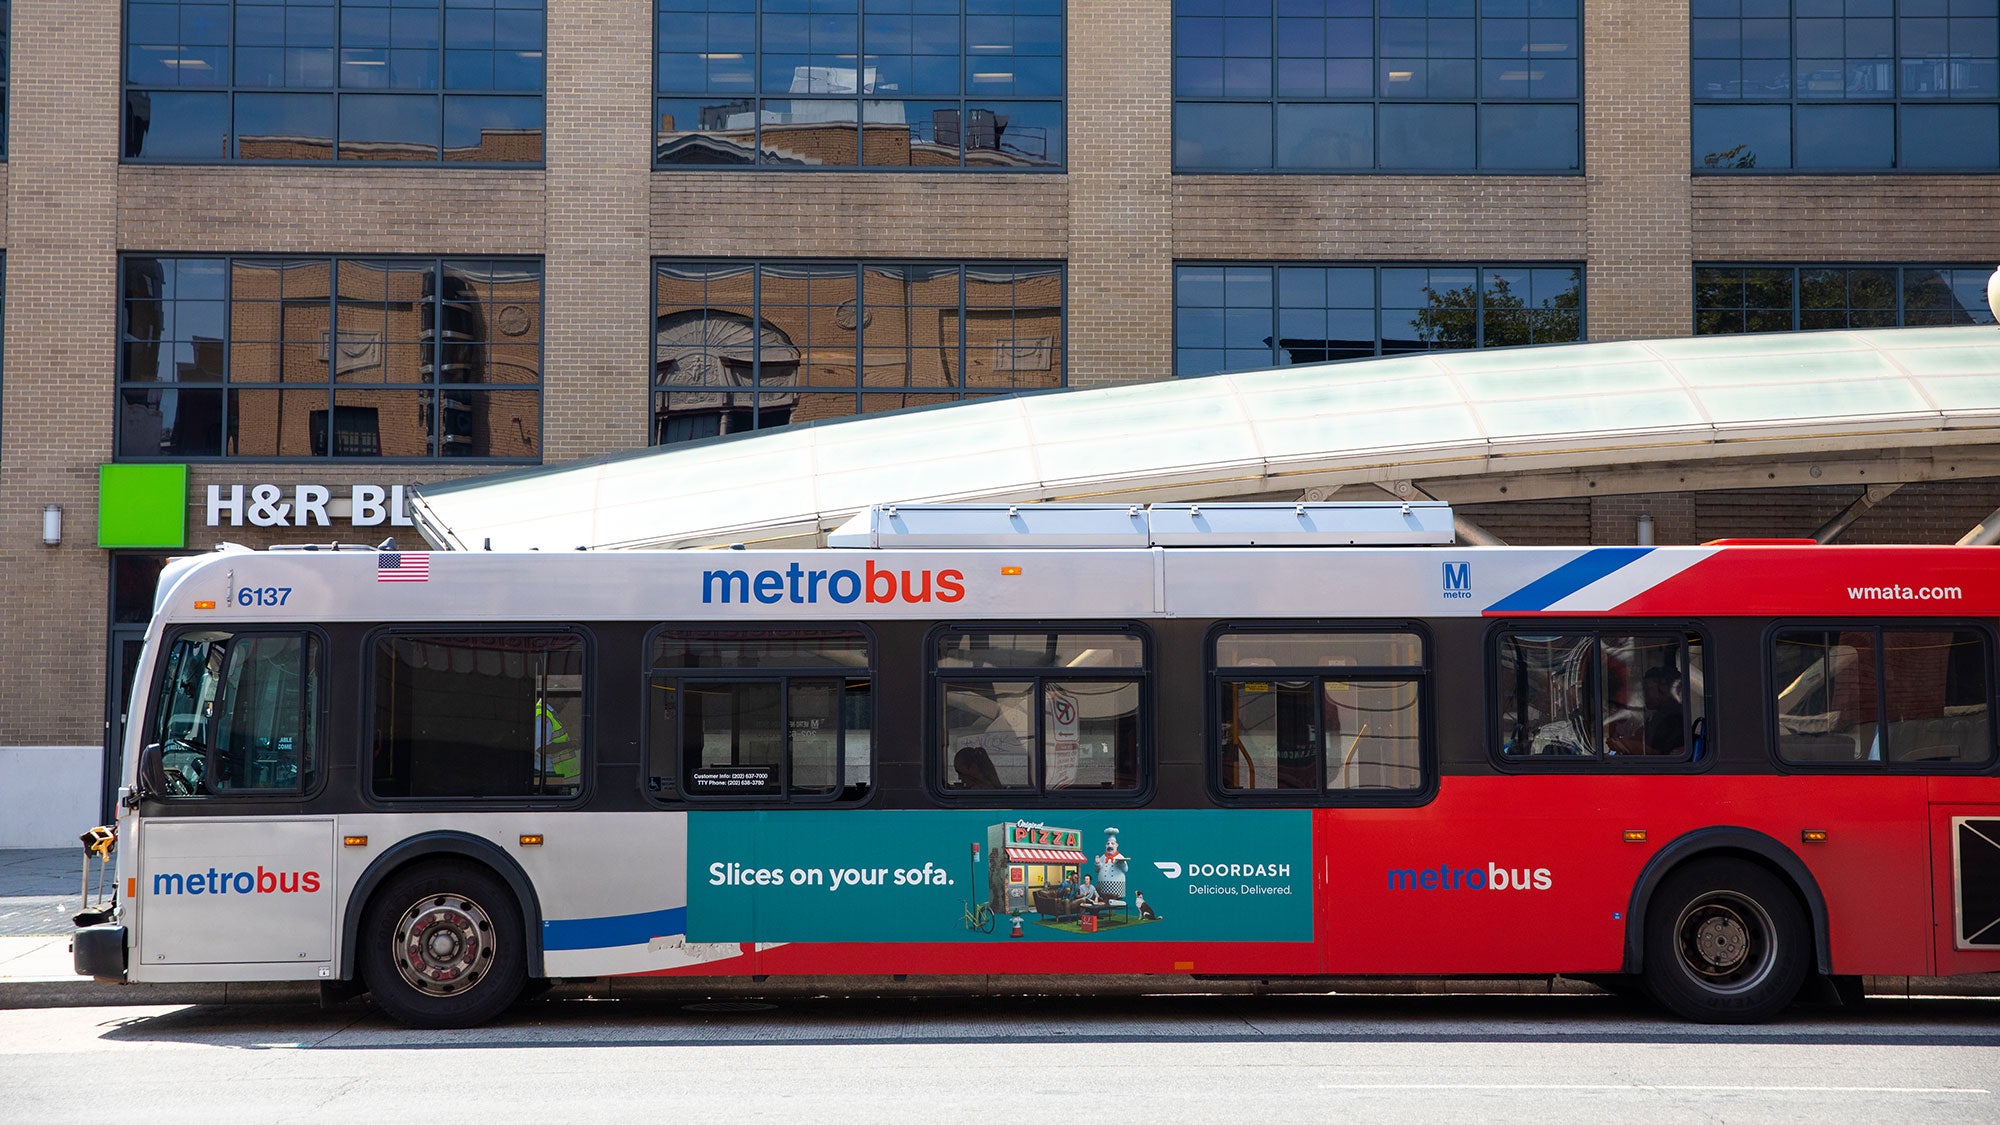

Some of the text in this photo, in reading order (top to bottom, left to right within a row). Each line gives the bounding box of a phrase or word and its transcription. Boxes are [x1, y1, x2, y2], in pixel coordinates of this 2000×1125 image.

[206, 483, 331, 527] H&R
[702, 559, 966, 604] metrobus
[237, 587, 292, 607] 6137
[1443, 591, 1472, 599] metro
[1847, 584, 1962, 600] wmata.com
[1016, 819, 1045, 832] Original
[1014, 828, 1077, 846] PIZZA
[709, 862, 954, 892] Slices on your sofa.
[1188, 863, 1291, 877] DOORDASH
[1387, 862, 1552, 891] metrobus
[153, 865, 320, 895] metrobus
[1189, 884, 1292, 897] Delicious, Delivered.
